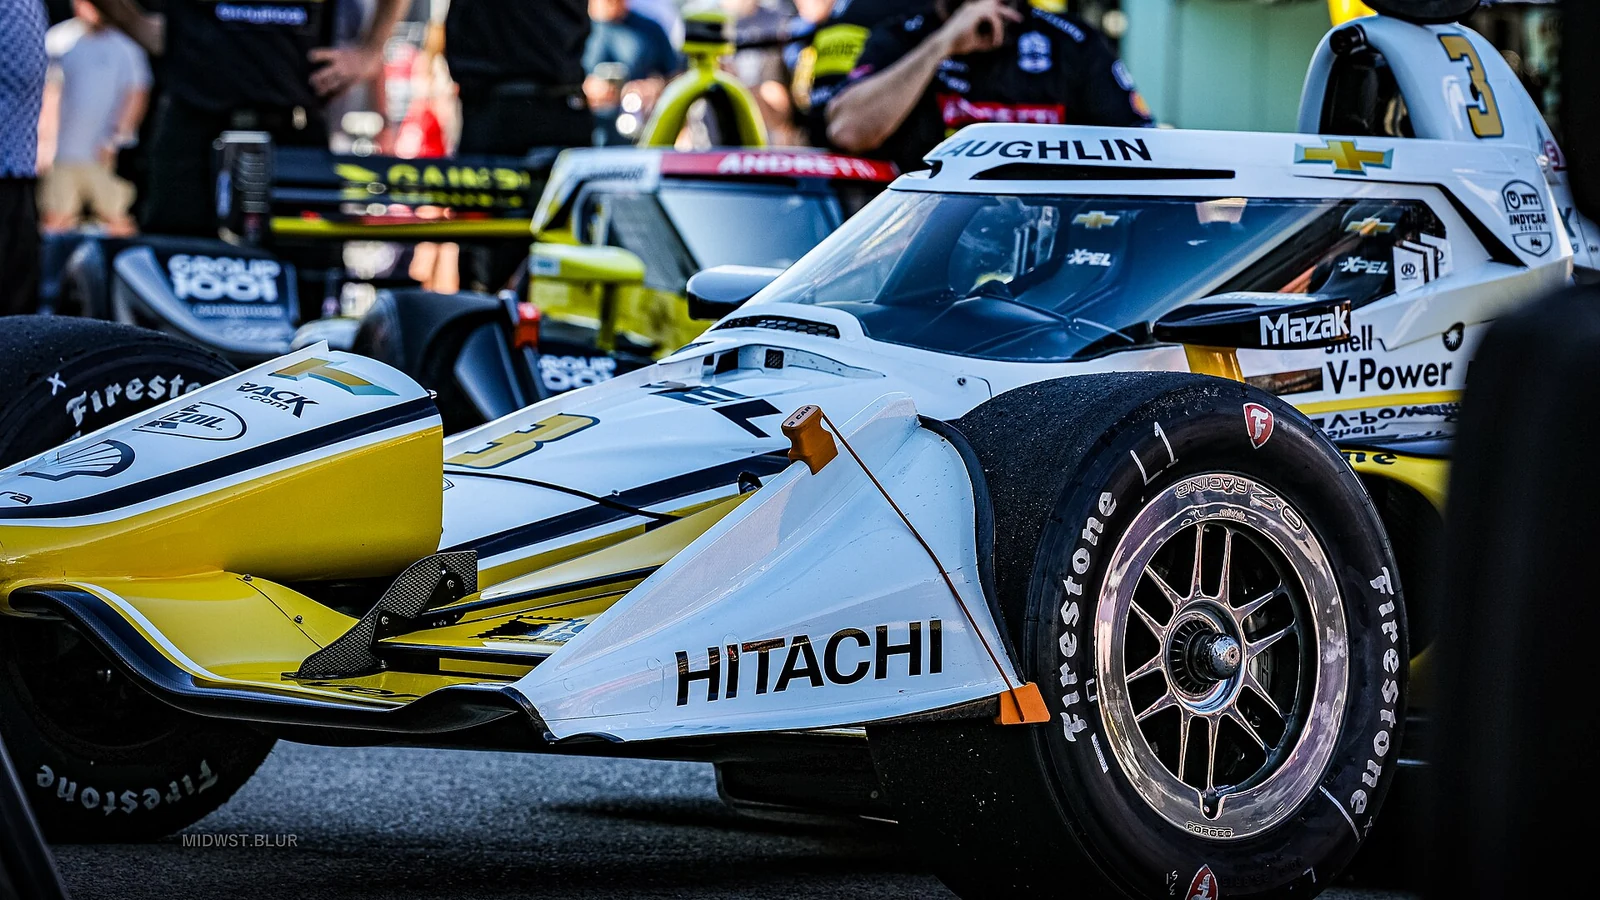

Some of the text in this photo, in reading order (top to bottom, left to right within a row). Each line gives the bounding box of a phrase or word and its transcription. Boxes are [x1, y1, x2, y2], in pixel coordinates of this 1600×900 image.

[1437, 33, 1504, 138] 3
[1509, 213, 1547, 226] INDYCAR
[168, 254, 281, 278] GROUP
[1069, 248, 1111, 268] XPEL
[1342, 256, 1388, 275] XPEL
[173, 272, 279, 302] 1001
[1259, 305, 1350, 346] Mazak
[1326, 358, 1453, 395] V-Power
[244, 395, 290, 411] .com
[796, 406, 812, 420] CAR
[441, 412, 600, 470] 3
[1175, 476, 1249, 500] RACING
[1059, 491, 1118, 743] Firestone
[675, 619, 942, 706] HITACHI
[1349, 566, 1400, 814] Firestone
[36, 760, 218, 816] Firestone
[1186, 821, 1234, 838] FORGED
